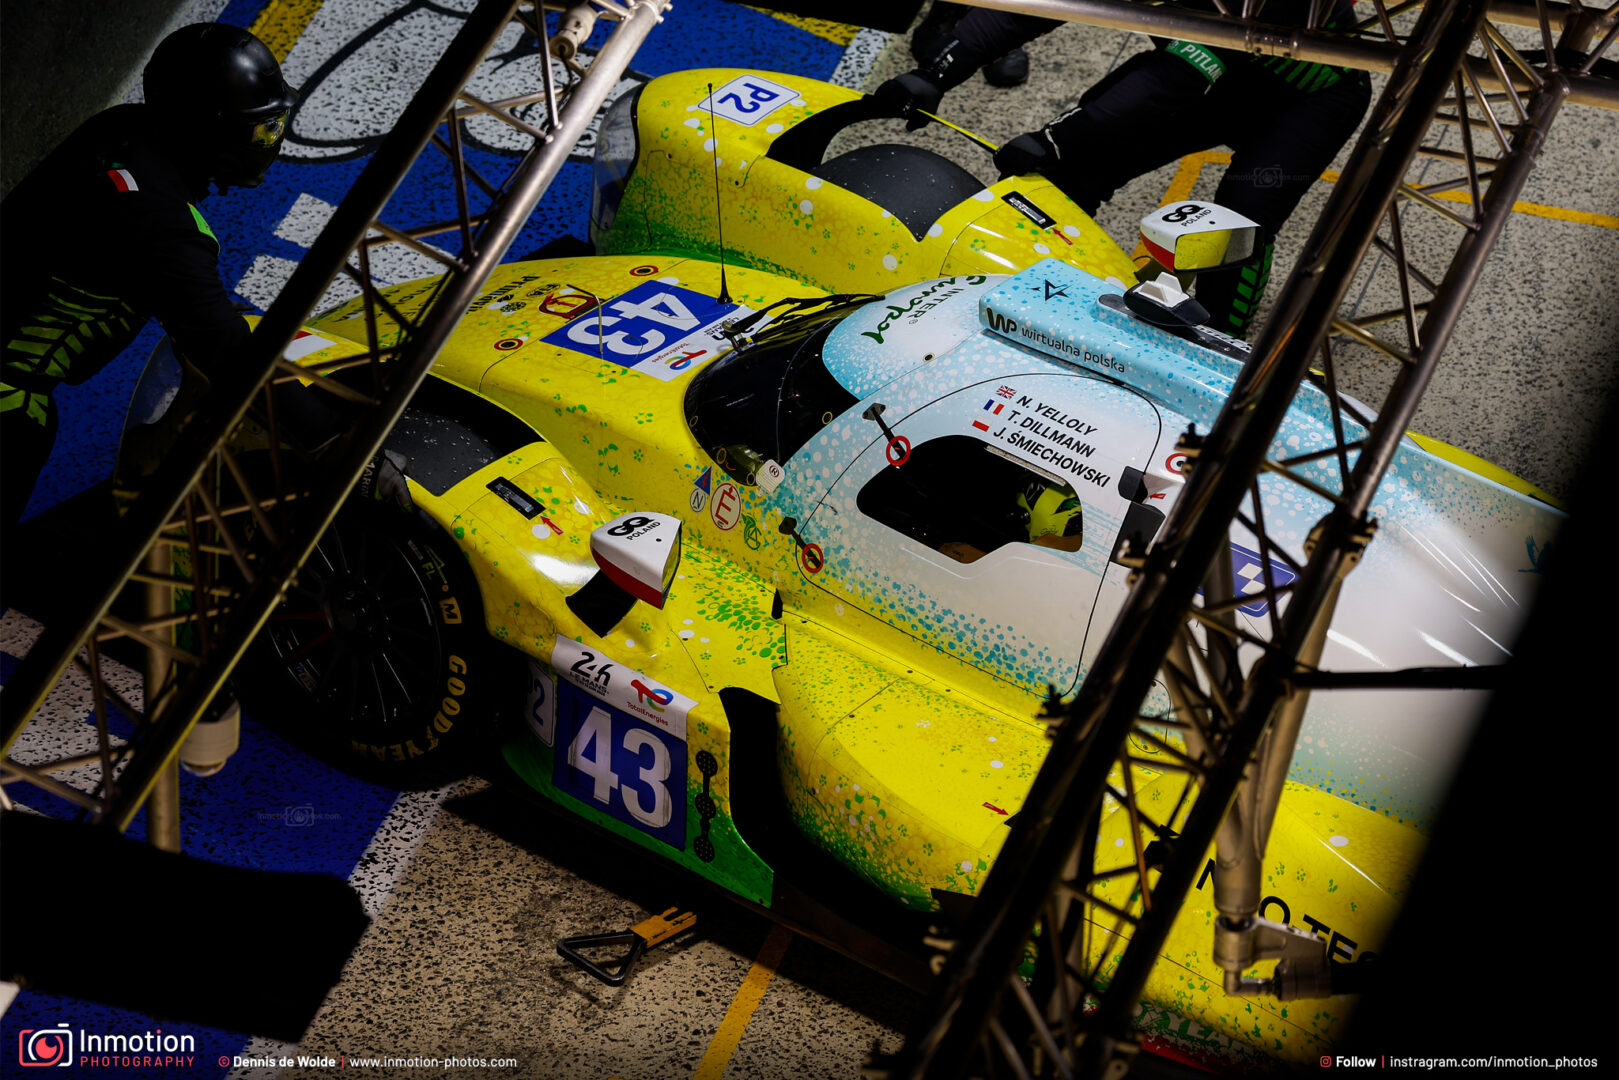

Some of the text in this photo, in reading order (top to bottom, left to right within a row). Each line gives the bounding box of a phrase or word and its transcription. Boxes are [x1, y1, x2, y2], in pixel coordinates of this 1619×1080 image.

[717, 82, 780, 113] P2
[1162, 204, 1207, 223] GQ
[1181, 209, 1212, 227] POLAND
[567, 291, 701, 356] 43
[986, 307, 1125, 373] WP wirtualna polska
[1016, 395, 1098, 436] N. YELLOLY
[1007, 410, 1096, 458] T. DILLMANN
[993, 426, 1111, 488] J. ŚMIECHOWSKI
[607, 516, 656, 537] GQ
[626, 521, 661, 541] POLAND
[626, 701, 668, 726] TotalEnergies
[567, 706, 673, 828] 43
